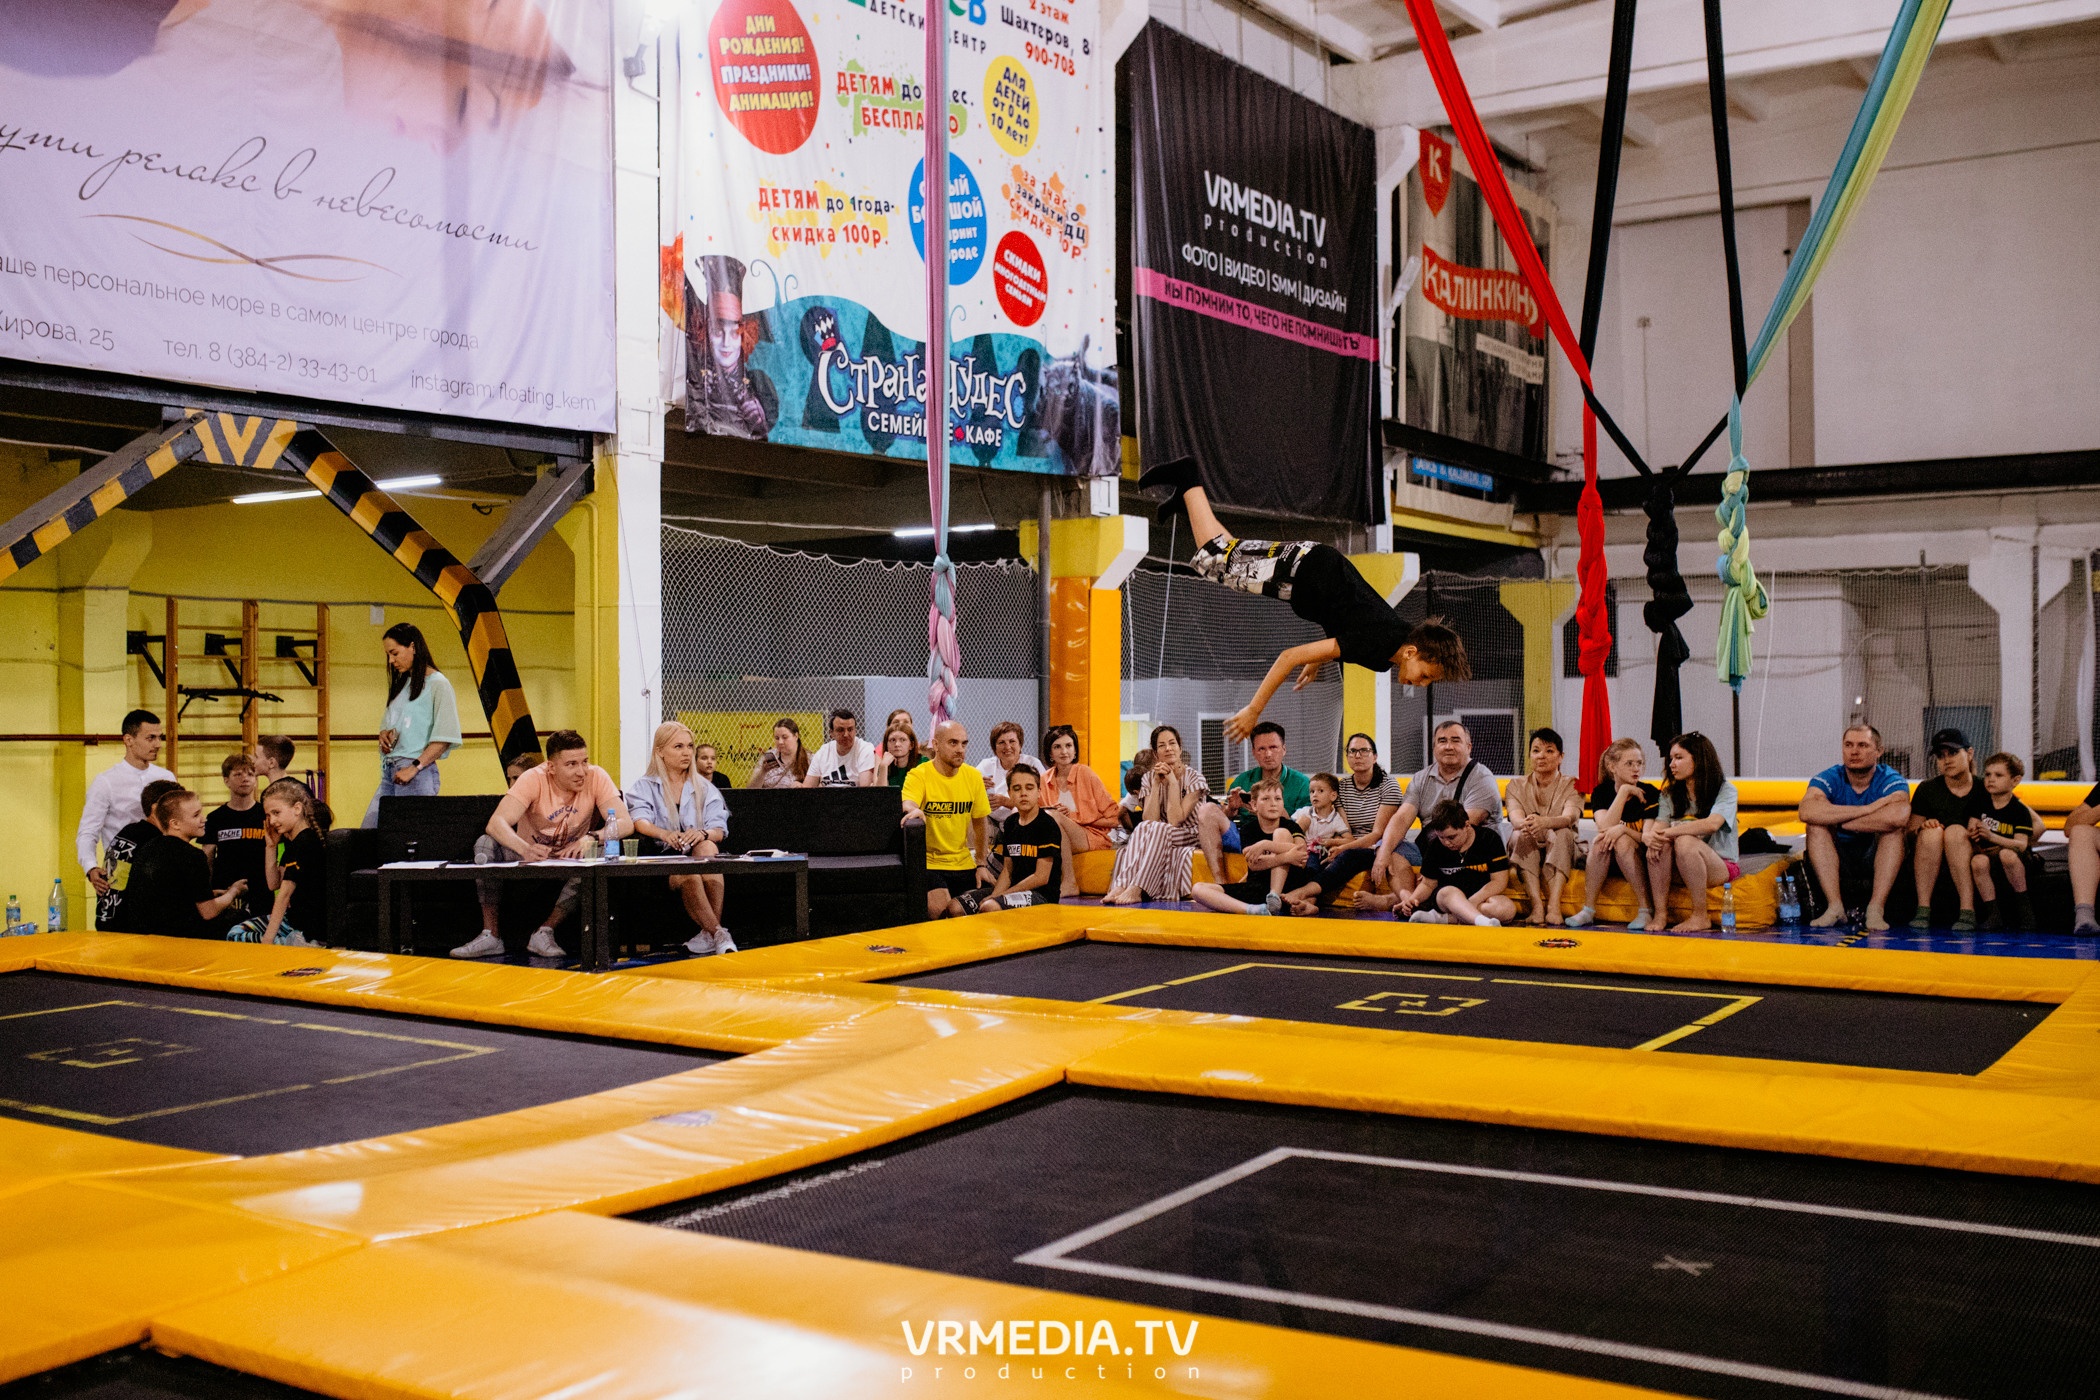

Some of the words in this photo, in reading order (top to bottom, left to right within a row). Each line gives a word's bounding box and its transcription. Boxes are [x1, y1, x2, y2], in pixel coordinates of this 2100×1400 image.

[746, 15, 776, 35] ДНИ
[870, 0, 925, 31] ДЕТСКИ
[948, 30, 986, 54] ЕНТР
[1040, 3, 1069, 24] этаж
[719, 36, 805, 57] РОЖДЕНИЯ!
[1025, 41, 1075, 76] 900-708
[1082, 38, 1090, 55] 8
[720, 63, 812, 85] ПРАЗДНИКИ!
[1003, 66, 1026, 92] ДЛЯ
[729, 90, 814, 112] АНИМАЦИЯ!
[837, 71, 895, 96] ДЕТЯМ
[949, 90, 974, 106] ес.
[996, 80, 1030, 114] ДЕТЕЙ
[861, 106, 959, 134] БЕСПЛАО
[991, 113, 1004, 130] 10
[1008, 104, 1014, 118] 0
[1429, 144, 1443, 183] К
[313, 166, 539, 251] невесомости
[758, 187, 820, 212] ДЕТЯМ
[1204, 169, 1327, 248] VRMEDIA.TV
[1204, 213, 1328, 269] production
[1003, 249, 1041, 283] СКИДКИ
[1181, 242, 1218, 271] ФОТО
[1225, 262, 1266, 287] ВИДЕО
[1271, 273, 1298, 298] SMM
[1302, 285, 1347, 314] ДИЗАЙН
[0, 256, 37, 278] ше
[44, 264, 205, 306] персональное
[211, 293, 265, 317] море
[271, 303, 280, 317] в
[286, 305, 347, 328] самом
[353, 316, 418, 342] центре
[423, 328, 479, 349] города
[1254, 307, 1280, 327] ЧЕГО
[1281, 315, 1295, 333] НЕ
[89, 328, 115, 351] 25
[163, 339, 202, 360] тел.
[208, 342, 221, 362] 8
[227, 344, 292, 371] (384-2)
[298, 357, 378, 384] 33-43-01
[965, 423, 1002, 447] КАФЕ
